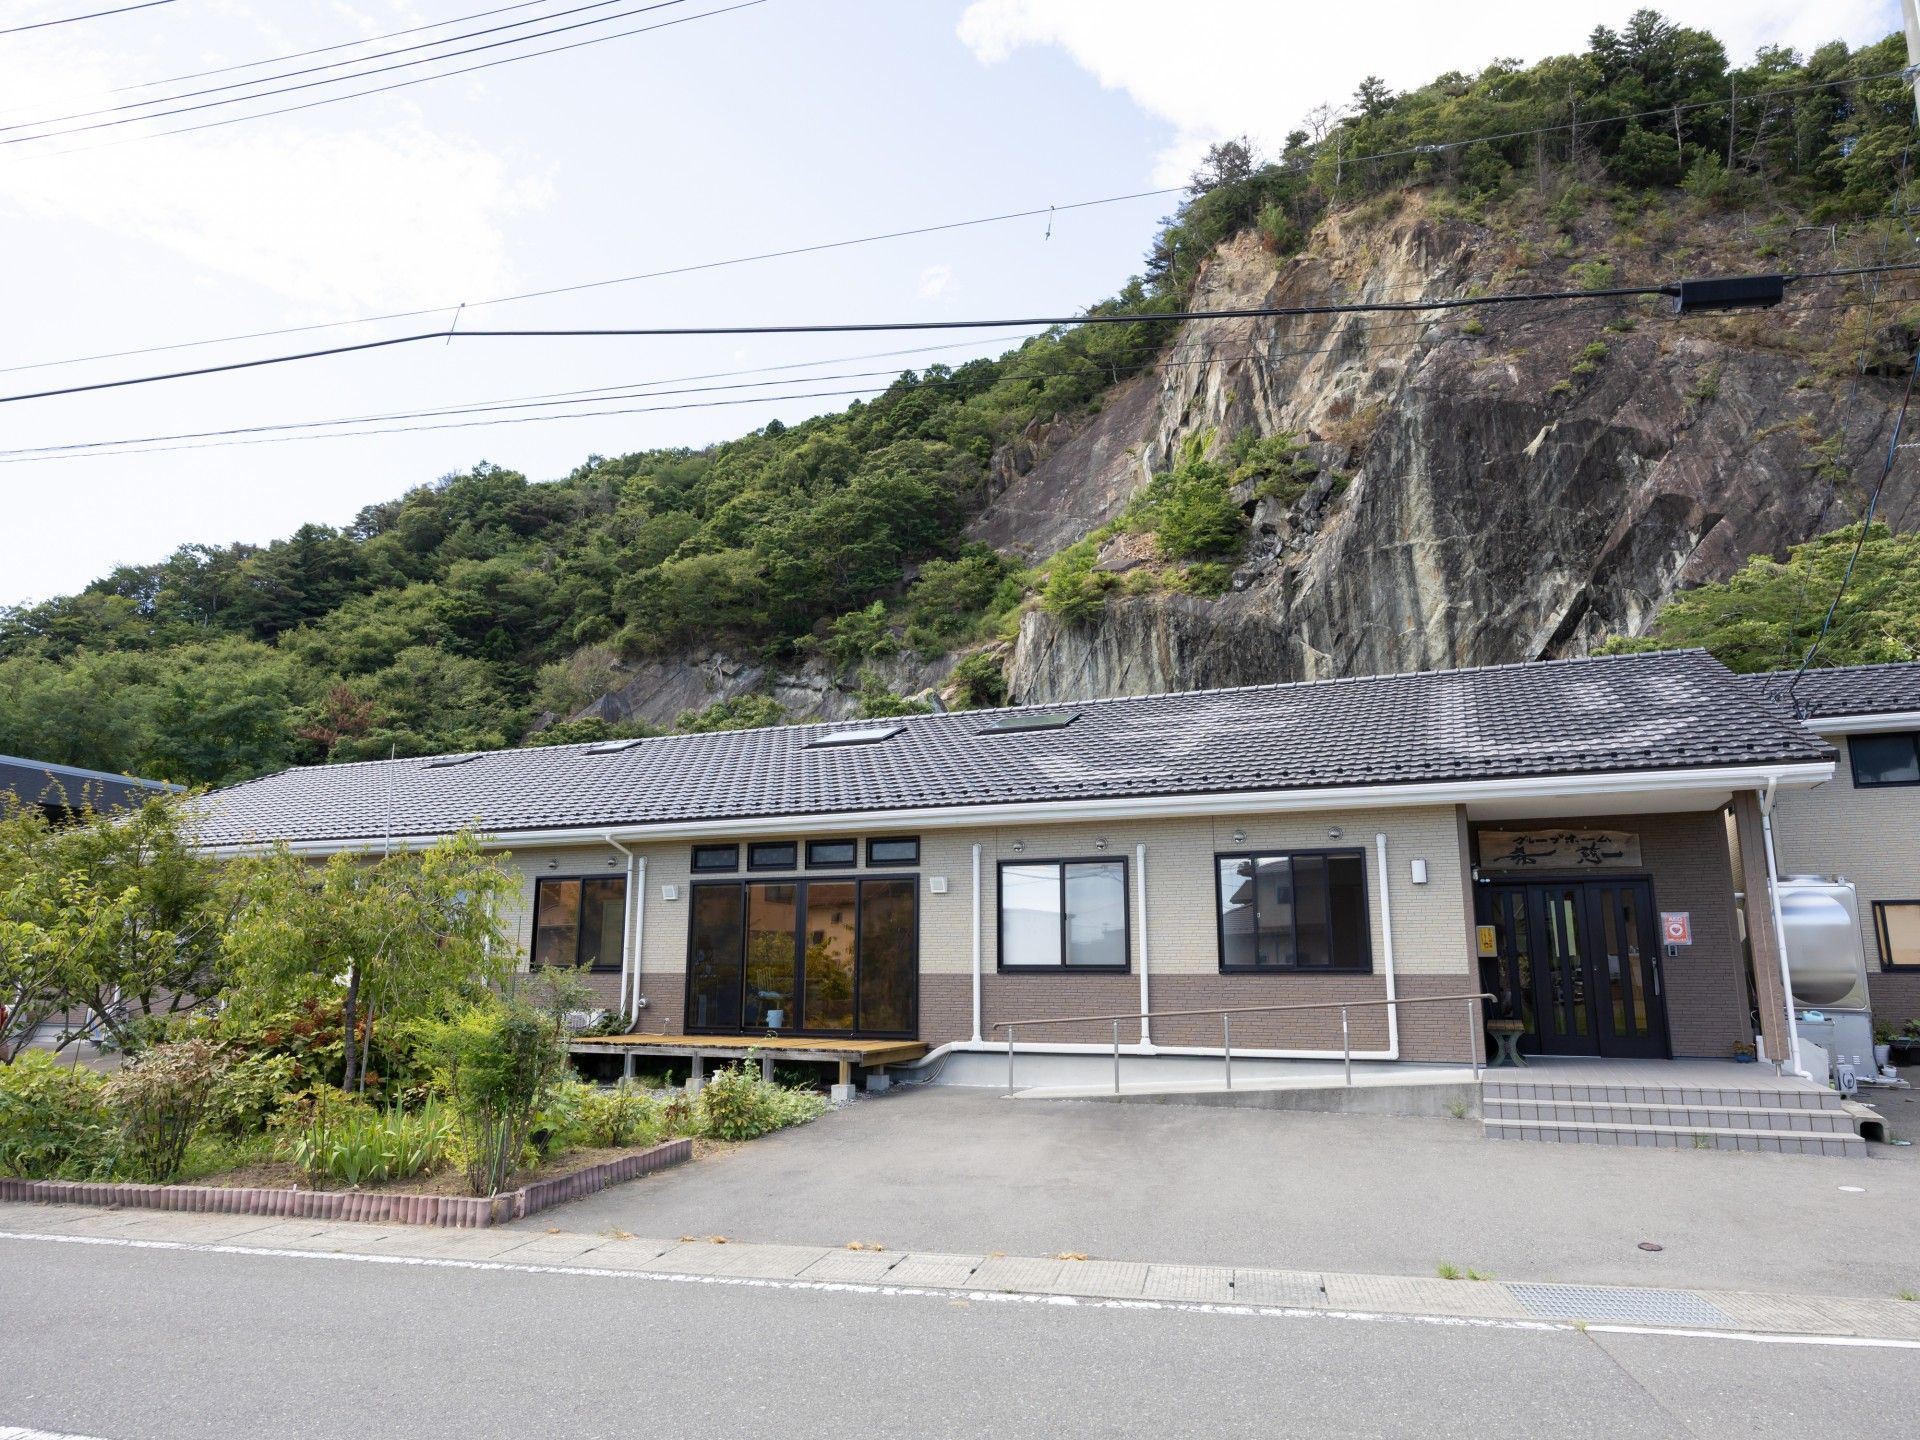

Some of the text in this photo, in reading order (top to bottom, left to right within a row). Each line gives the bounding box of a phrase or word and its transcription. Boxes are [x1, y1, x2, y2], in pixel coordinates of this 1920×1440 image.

[1512, 834, 1612, 845] グループホーム
